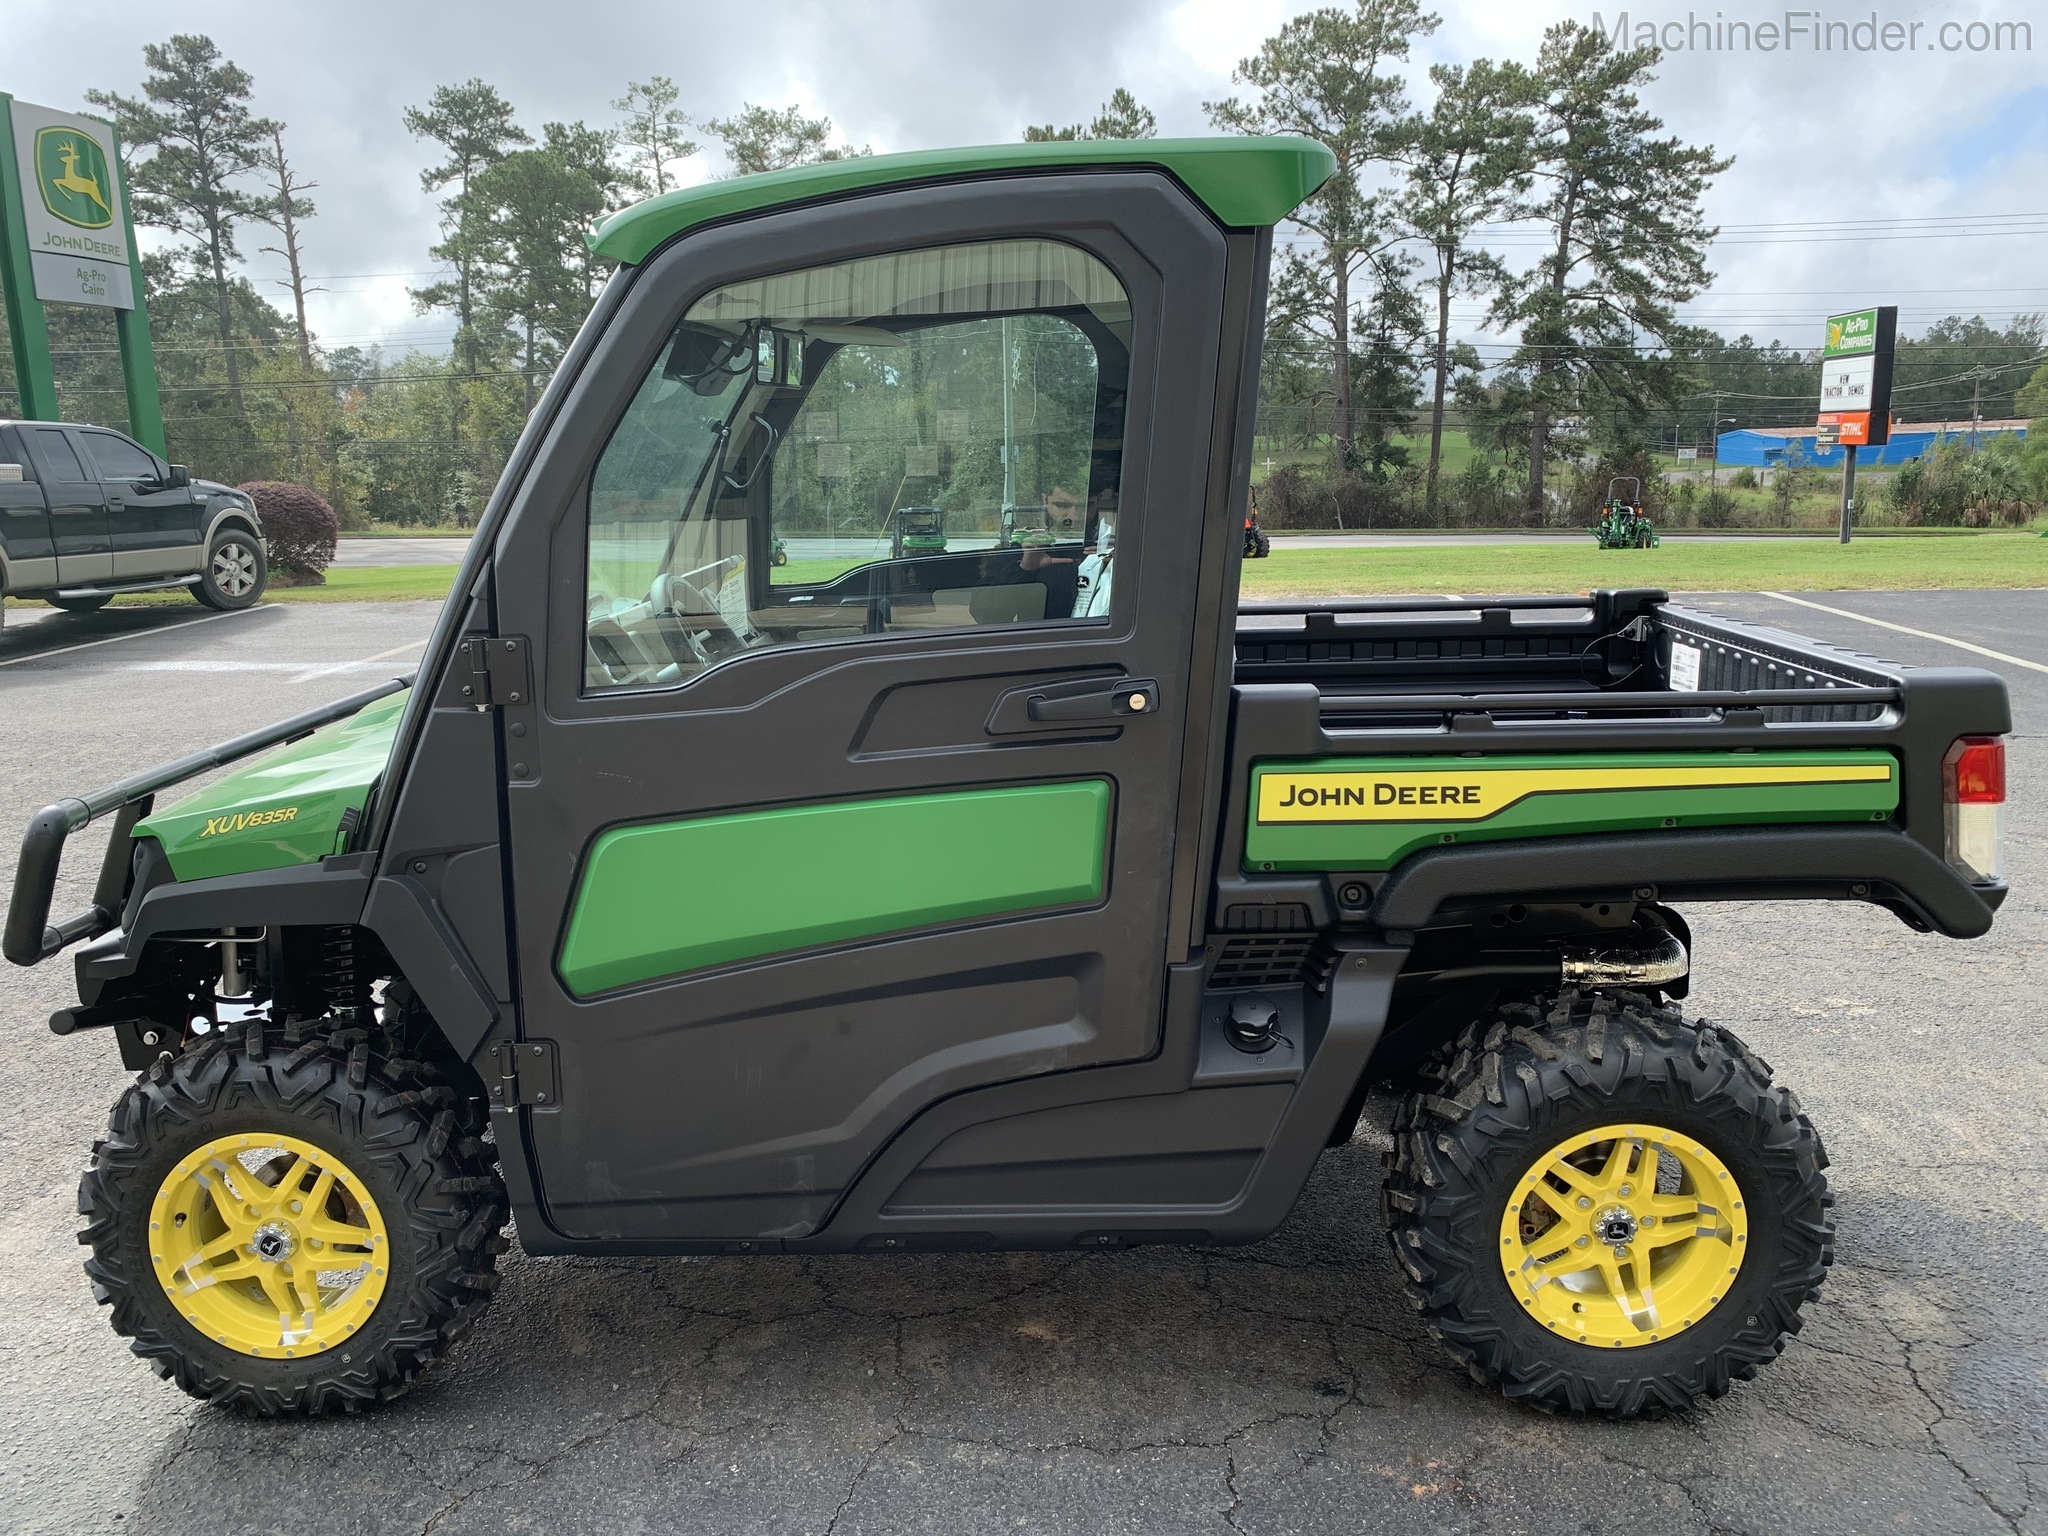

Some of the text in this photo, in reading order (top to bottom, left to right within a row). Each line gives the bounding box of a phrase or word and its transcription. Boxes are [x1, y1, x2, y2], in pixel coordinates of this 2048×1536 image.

[43, 232, 120, 257] JOHN DEERE
[76, 267, 106, 282] Ag-Pro
[82, 282, 105, 296] Cairo
[1824, 384, 1865, 397] TRACTOR DEMOS
[1840, 422, 1862, 436] STIHL
[1280, 784, 1480, 806] JOHN DEERE
[199, 807, 298, 839] XUV835R
